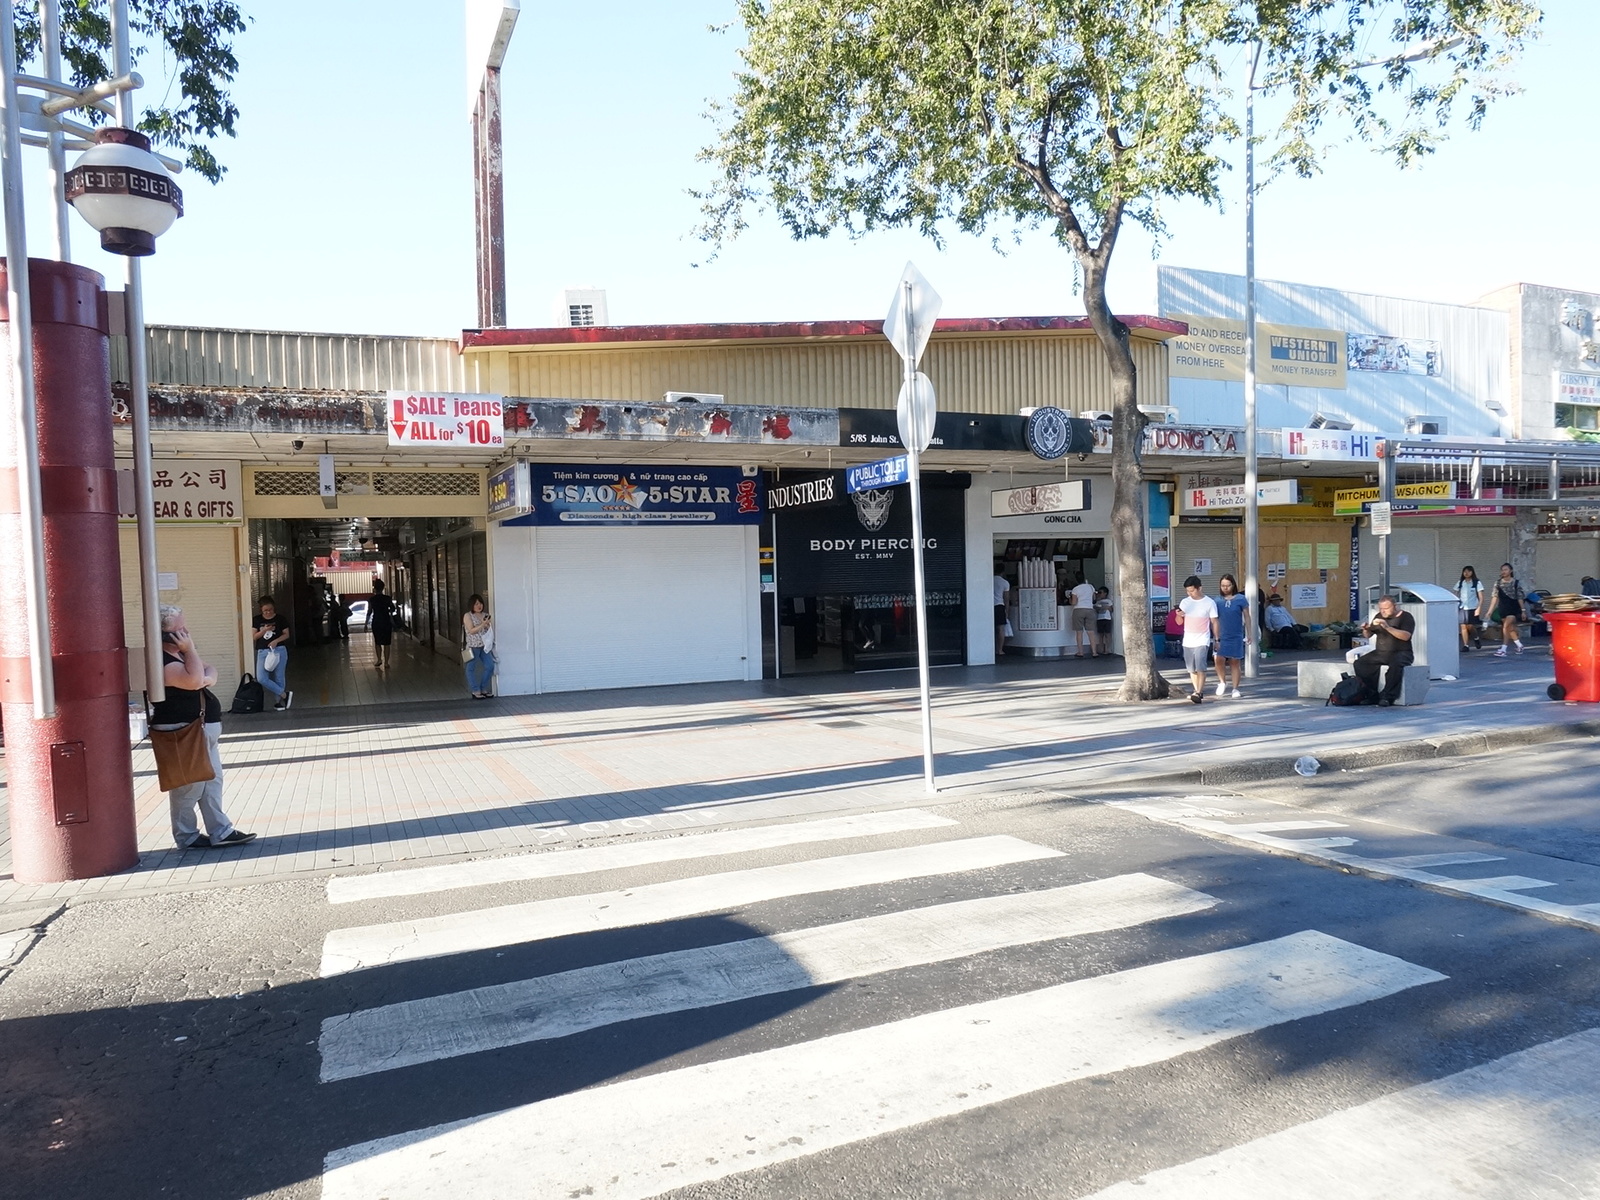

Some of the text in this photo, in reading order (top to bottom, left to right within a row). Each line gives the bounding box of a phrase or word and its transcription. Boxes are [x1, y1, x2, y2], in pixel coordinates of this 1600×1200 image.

[1201, 329, 1218, 339] AND
[1176, 341, 1246, 355] MONEY OVERSEA
[1271, 336, 1327, 351] WESTERN
[1176, 356, 1225, 368] FROM HERE
[1289, 349, 1327, 362] UNION
[1271, 365, 1337, 377] MONEY TRANSFER
[407, 395, 501, 417] $ALE jeans
[410, 421, 437, 441] ALL
[439, 428, 454, 441] for
[457, 419, 490, 444] $10
[492, 435, 502, 444] ea
[850, 434, 899, 444] 5/85 John St.
[1351, 435, 1368, 457] Hi
[855, 458, 906, 481] PUBLIC TOILET
[575, 472, 590, 480] kim
[654, 473, 675, 482] trang
[861, 478, 882, 487] THROUGH
[648, 485, 731, 503] 5-STAR
[1337, 485, 1448, 501] MITCHUM WSAGNCY
[1209, 496, 1246, 506] Hi Tech Zo
[184, 501, 192, 518] &
[197, 501, 234, 518] GIFTS
[1044, 515, 1082, 523] GONG CHA
[810, 539, 856, 551] BODY
[1350, 536, 1359, 590] Lotteries
